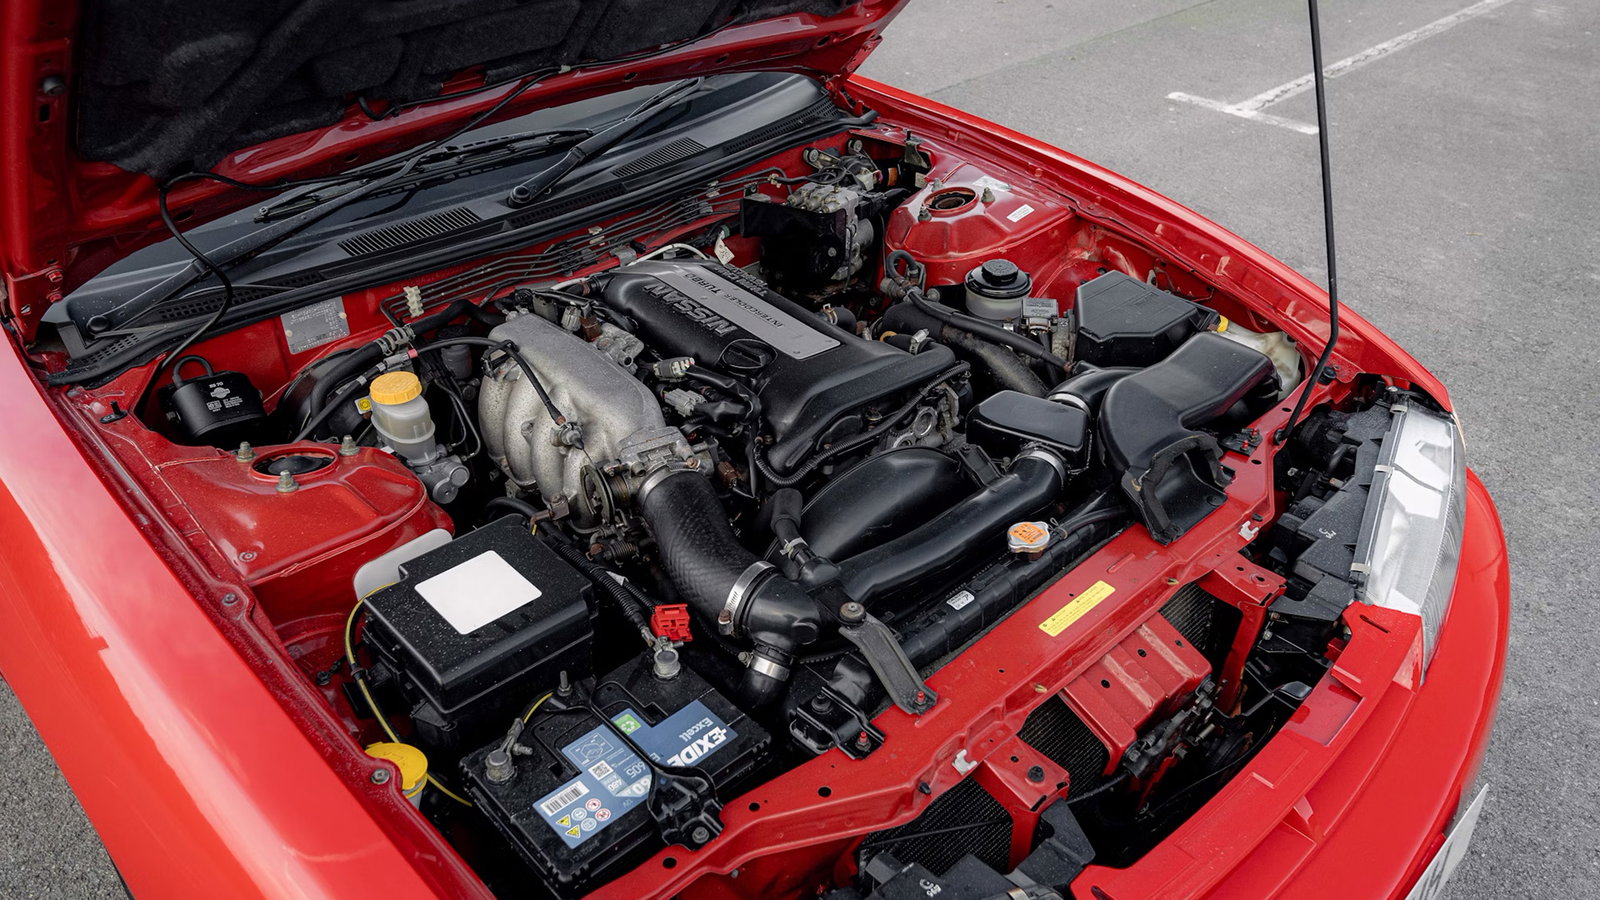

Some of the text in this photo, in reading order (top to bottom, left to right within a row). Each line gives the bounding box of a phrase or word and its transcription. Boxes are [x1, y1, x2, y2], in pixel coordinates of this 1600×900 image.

[643, 283, 738, 336] NISSAN
[684, 273, 784, 328] INTERCOOLER TURBO
[667, 726, 727, 767] EXIDE
[679, 717, 714, 742] Excell
